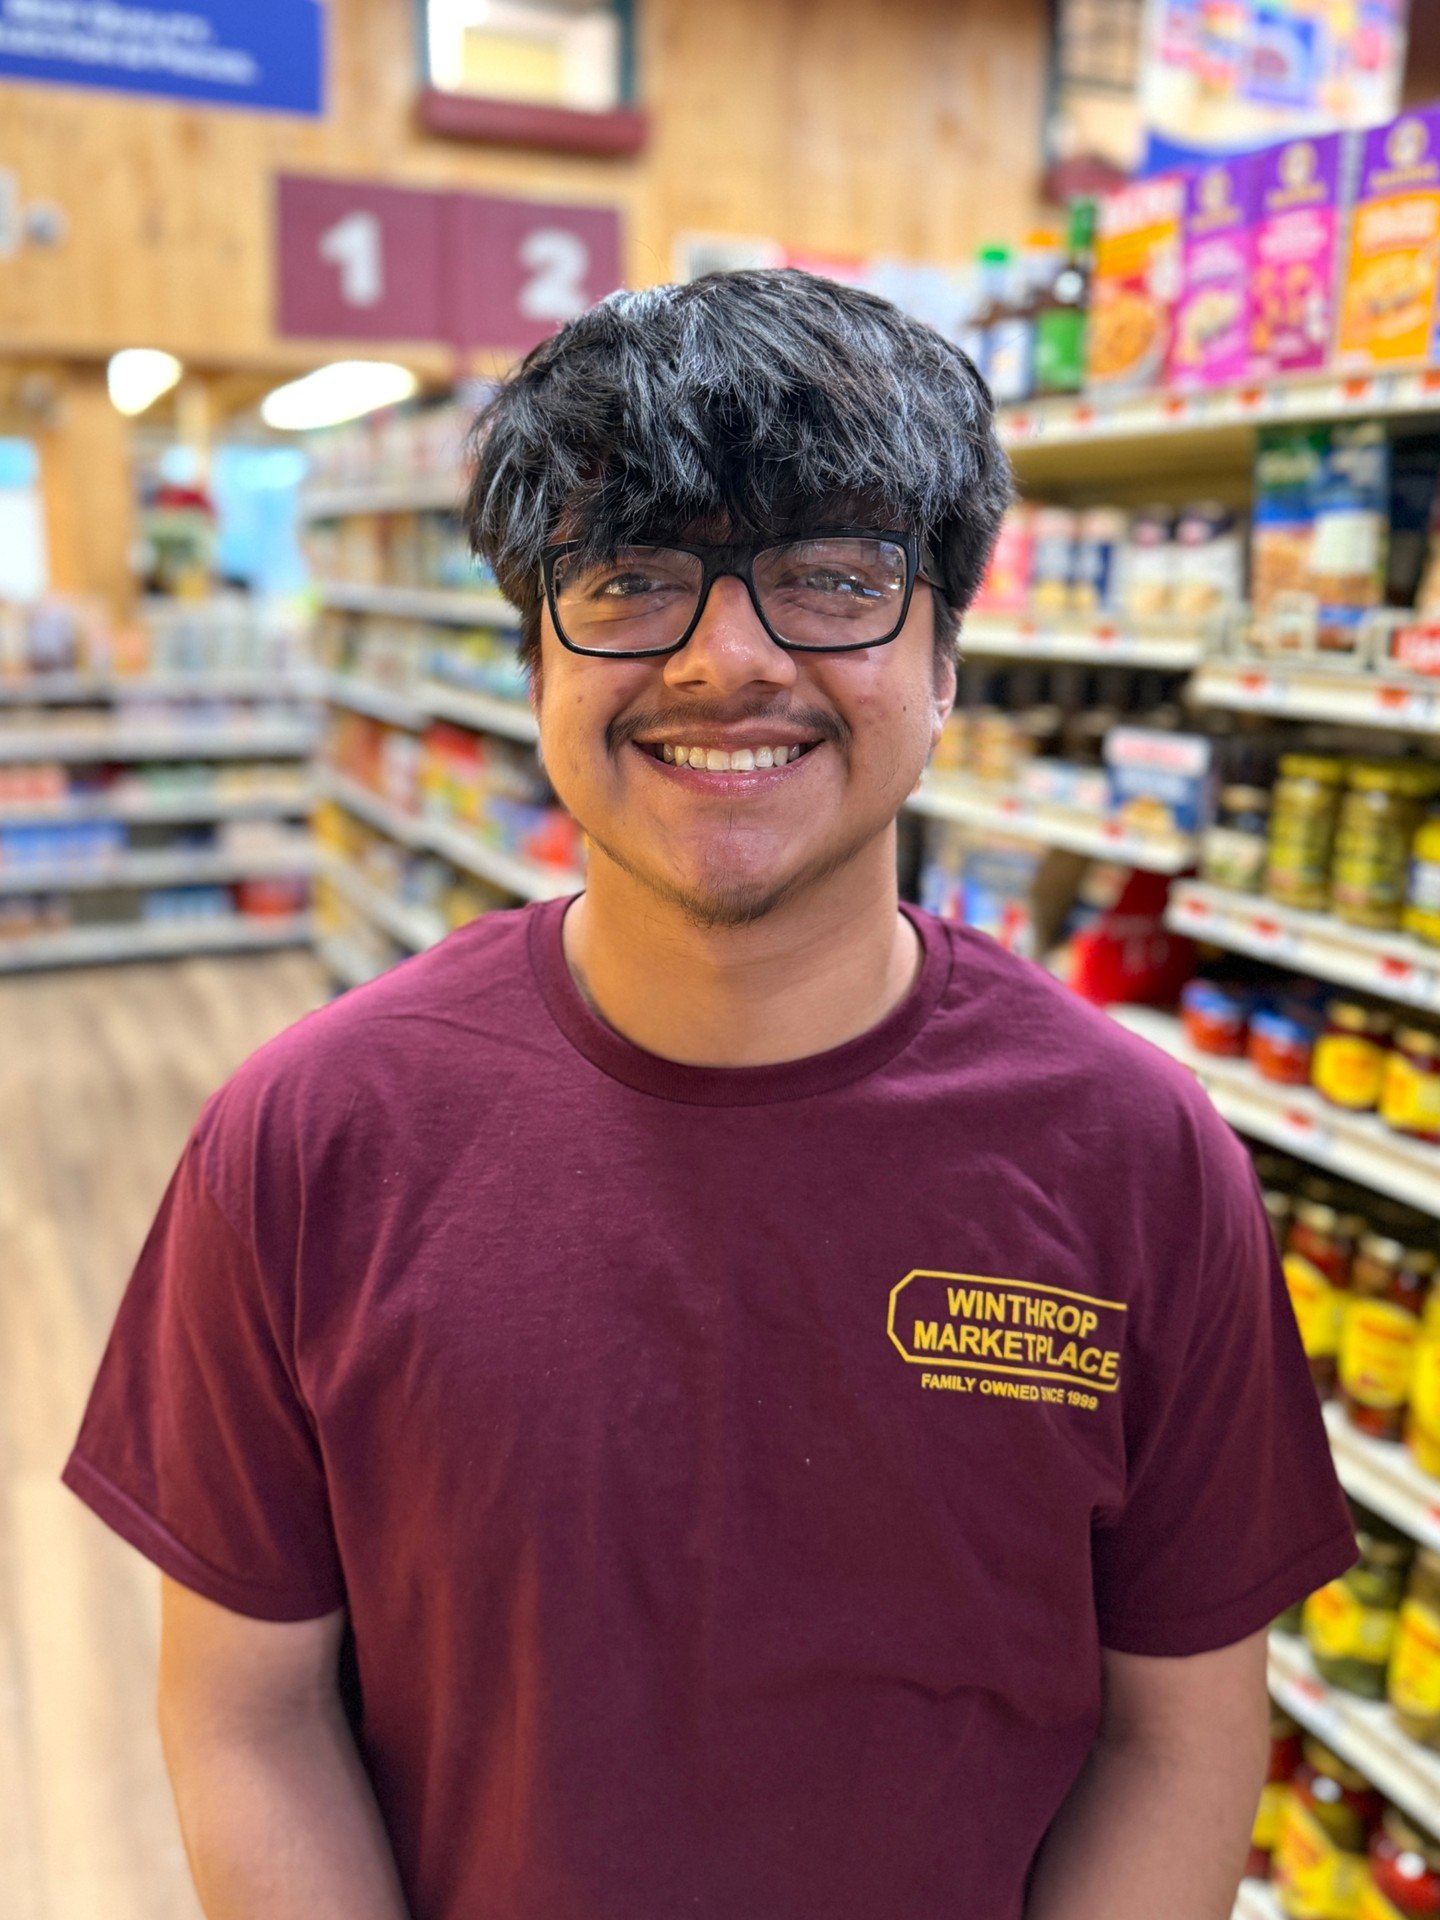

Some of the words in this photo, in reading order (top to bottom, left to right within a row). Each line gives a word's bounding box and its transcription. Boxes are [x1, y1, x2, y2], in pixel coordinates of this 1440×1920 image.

[320, 211, 382, 307] 1
[519, 229, 589, 319] 2
[947, 1288, 1097, 1337] WINTHROP
[913, 1320, 1119, 1378] MARKETPLACE
[921, 1373, 976, 1392] FAMILY
[980, 1380, 1039, 1401] OWNED
[1041, 1386, 1065, 1403] SNCE
[1067, 1391, 1098, 1410] 1999
